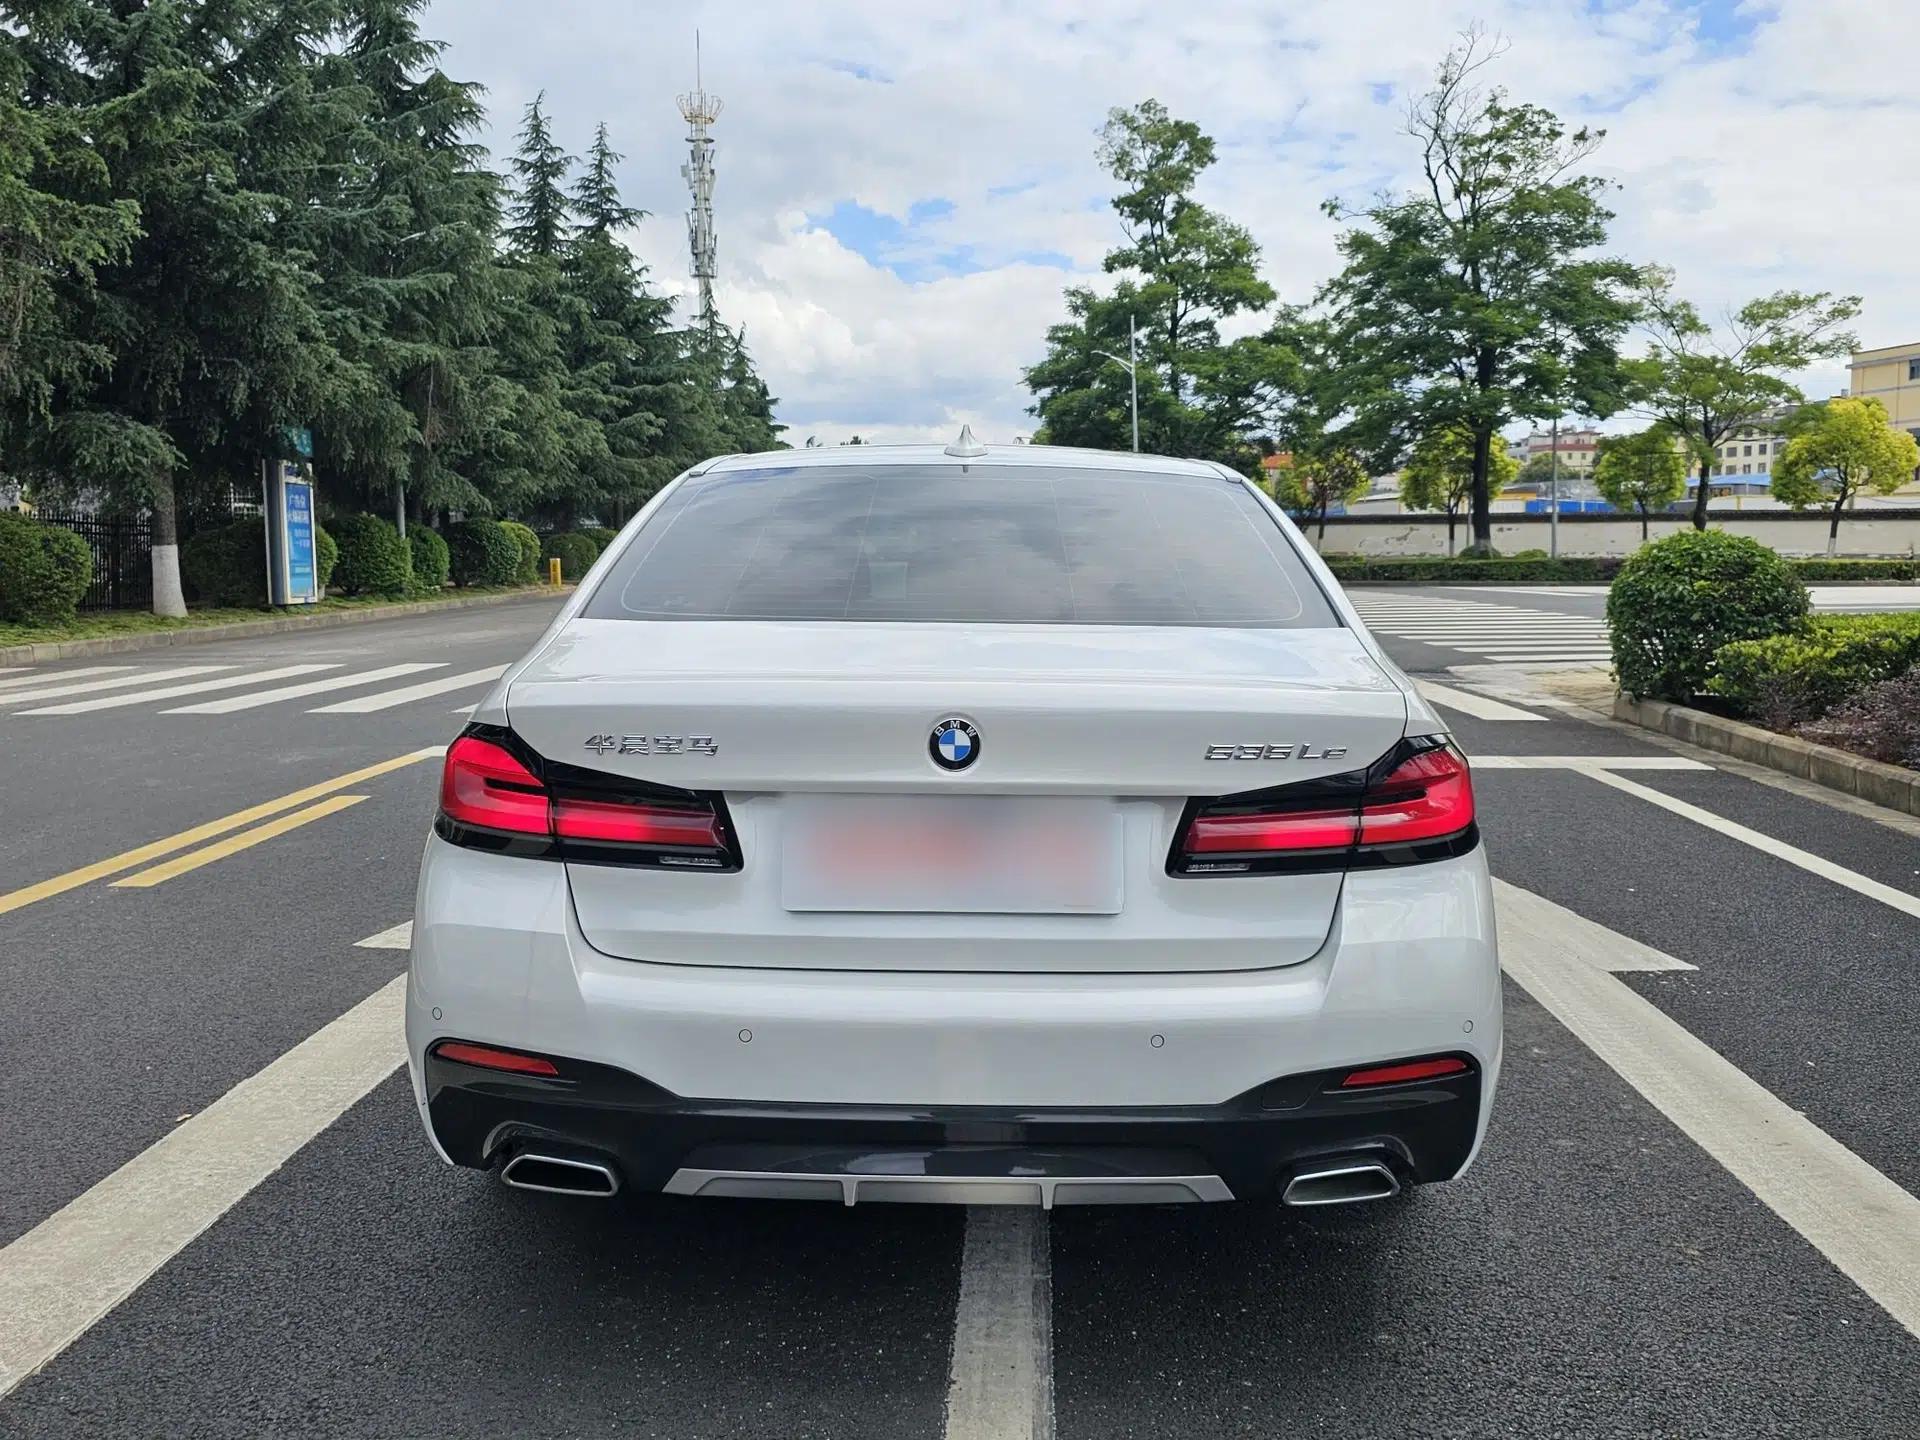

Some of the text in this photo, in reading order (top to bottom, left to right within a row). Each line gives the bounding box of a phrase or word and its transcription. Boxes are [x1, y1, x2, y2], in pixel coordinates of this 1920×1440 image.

[935, 720, 977, 737] BMW
[584, 734, 719, 755] 华晨宝马
